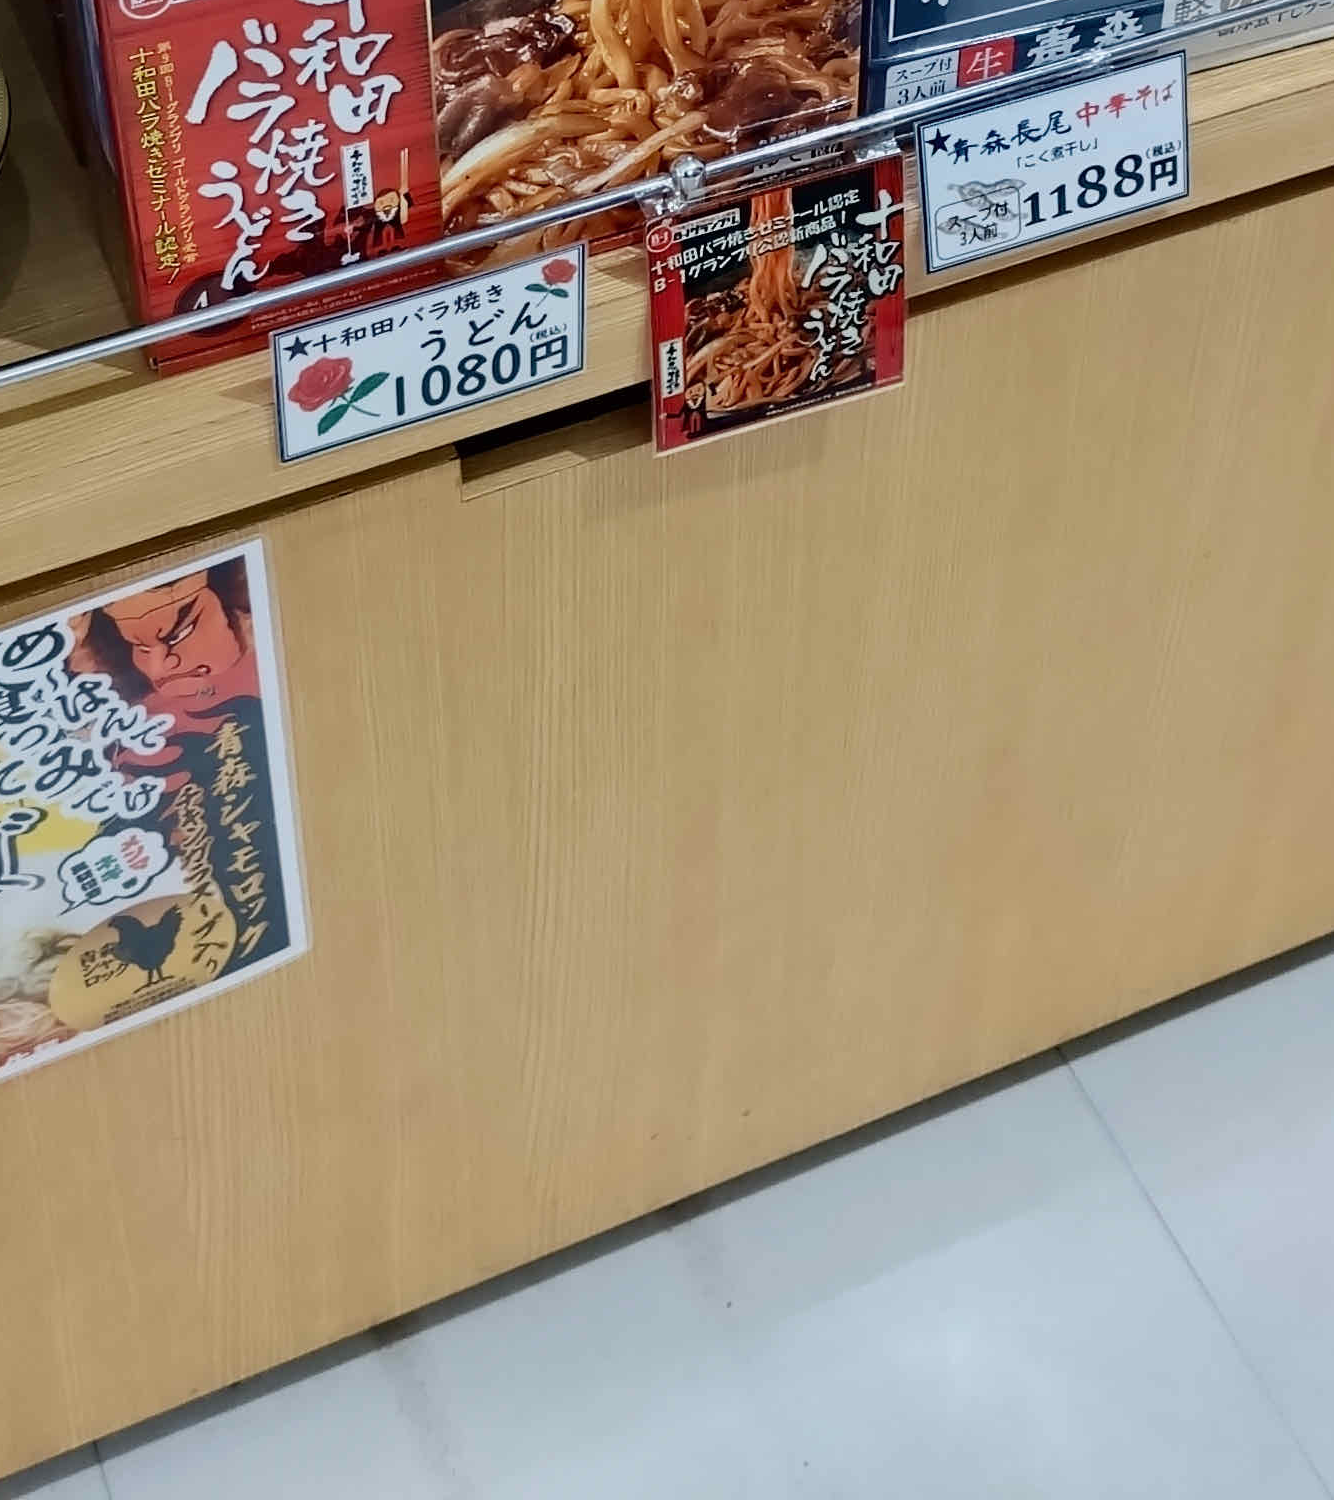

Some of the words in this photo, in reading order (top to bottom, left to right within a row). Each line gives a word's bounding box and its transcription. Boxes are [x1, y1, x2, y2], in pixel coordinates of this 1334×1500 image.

[894, 56, 955, 83] スープ付
[968, 46, 1007, 85] 生
[184, 19, 336, 242] バラ焼き
[197, 160, 270, 292] うどん
[947, 202, 1010, 231] スープ付
[1022, 153, 1179, 228] 1188円
[855, 188, 905, 296] 十和田
[959, 223, 999, 247] 3人前
[312, 284, 505, 354] 十和田バラ焼き
[419, 300, 548, 362] うどん
[800, 232, 866, 356] バラ焼き
[395, 333, 570, 417] 1080円
[802, 308, 838, 382] うどん
[204, 714, 269, 957] 青森シャモロック
